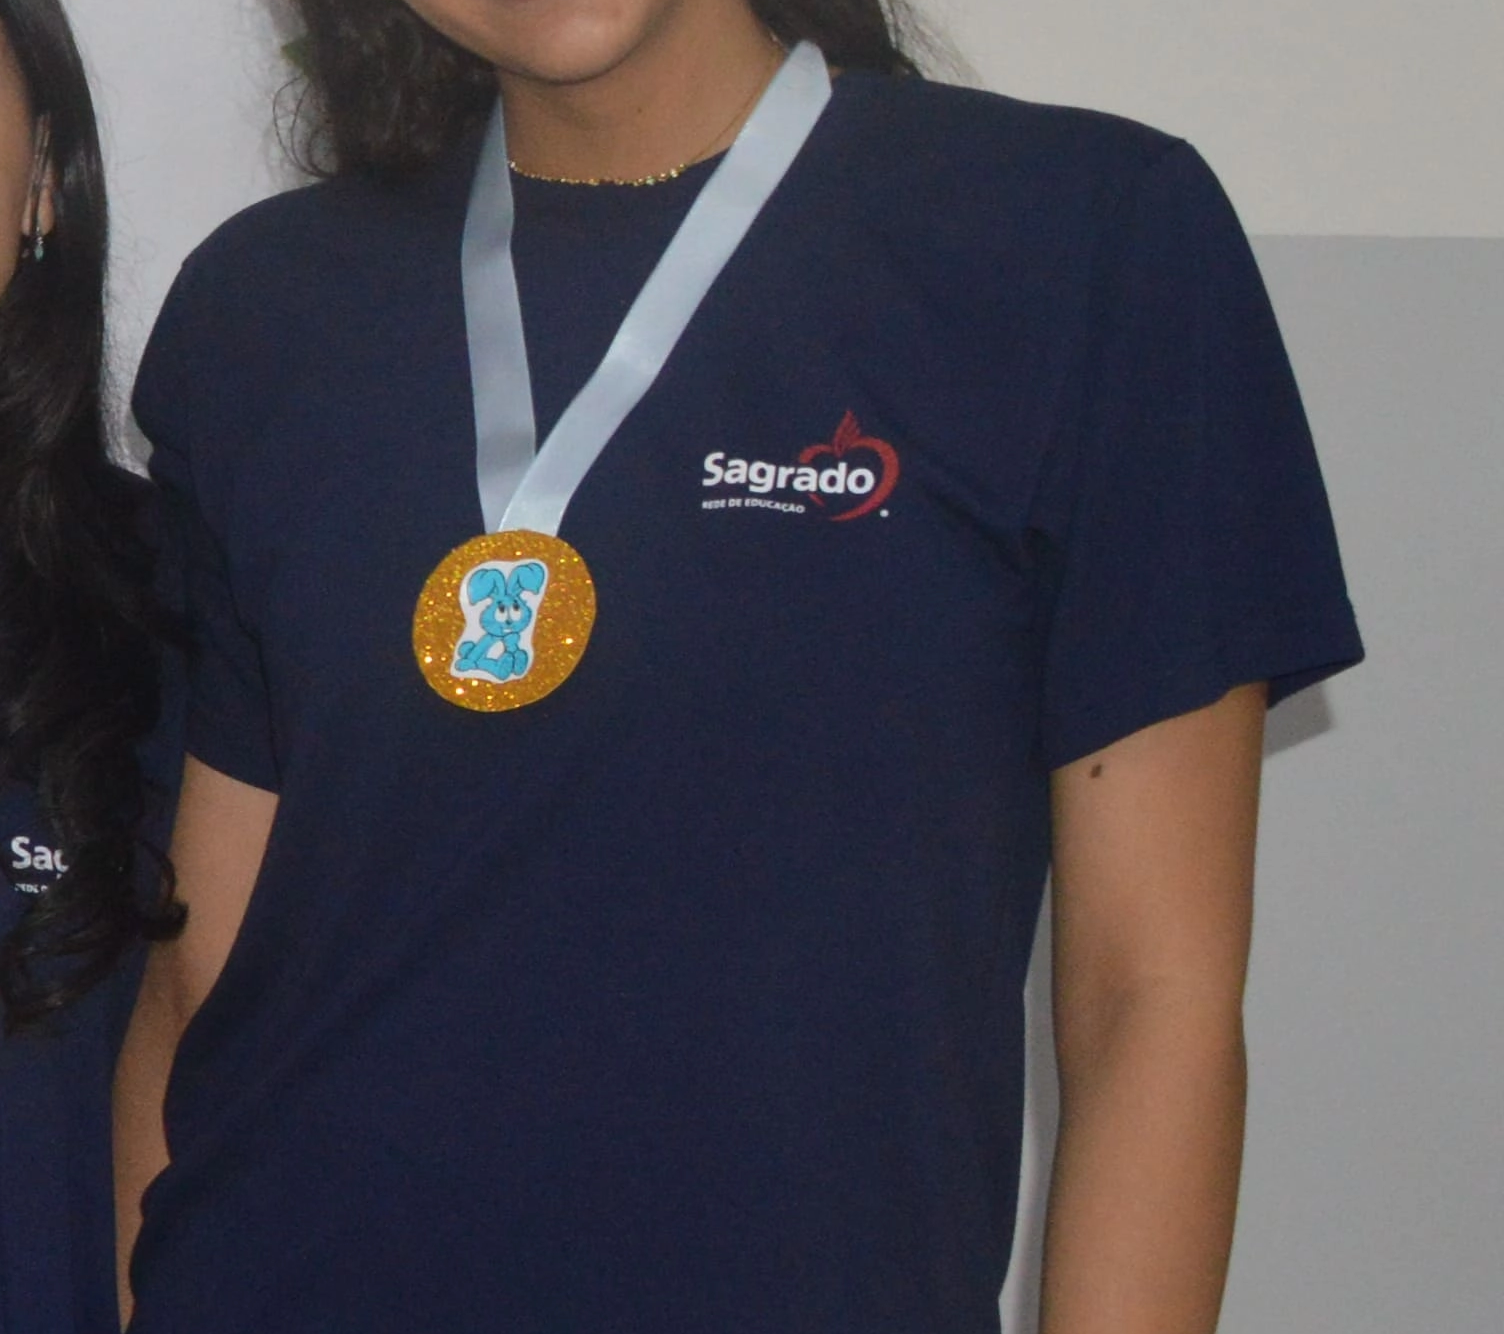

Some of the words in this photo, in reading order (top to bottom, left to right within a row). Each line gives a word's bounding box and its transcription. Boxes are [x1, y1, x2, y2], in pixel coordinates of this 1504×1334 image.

[702, 452, 875, 494] Sagrado
[702, 499, 727, 509] REDE
[728, 498, 742, 507] DE
[744, 498, 806, 514] EDUCAÇÃO
